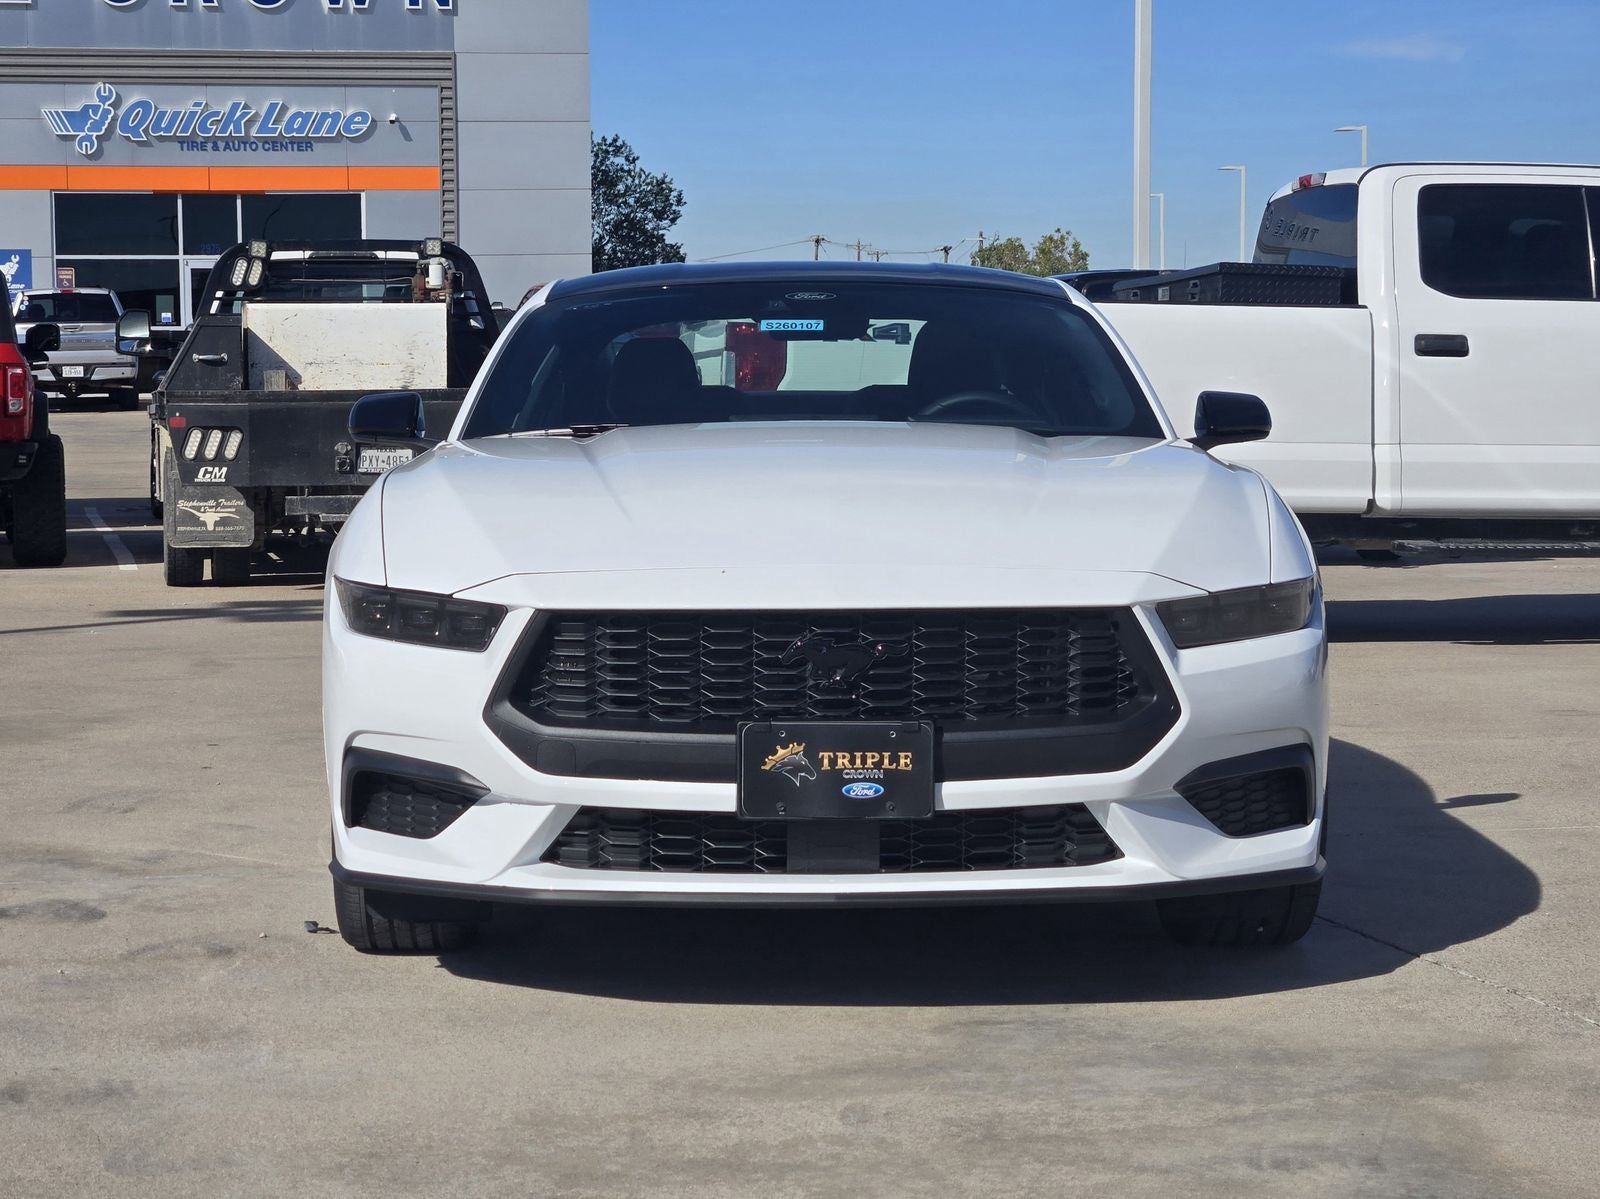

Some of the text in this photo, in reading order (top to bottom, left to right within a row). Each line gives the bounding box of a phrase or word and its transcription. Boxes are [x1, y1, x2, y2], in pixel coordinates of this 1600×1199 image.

[117, 98, 372, 141] Quick Lane
[177, 141, 314, 152] TIRE & AUTO CENTER
[765, 321, 822, 330] S260107
[197, 466, 228, 479] CM
[818, 752, 913, 771] TRIPLE
[842, 769, 884, 779] CROWN
[849, 785, 876, 796] Ford
